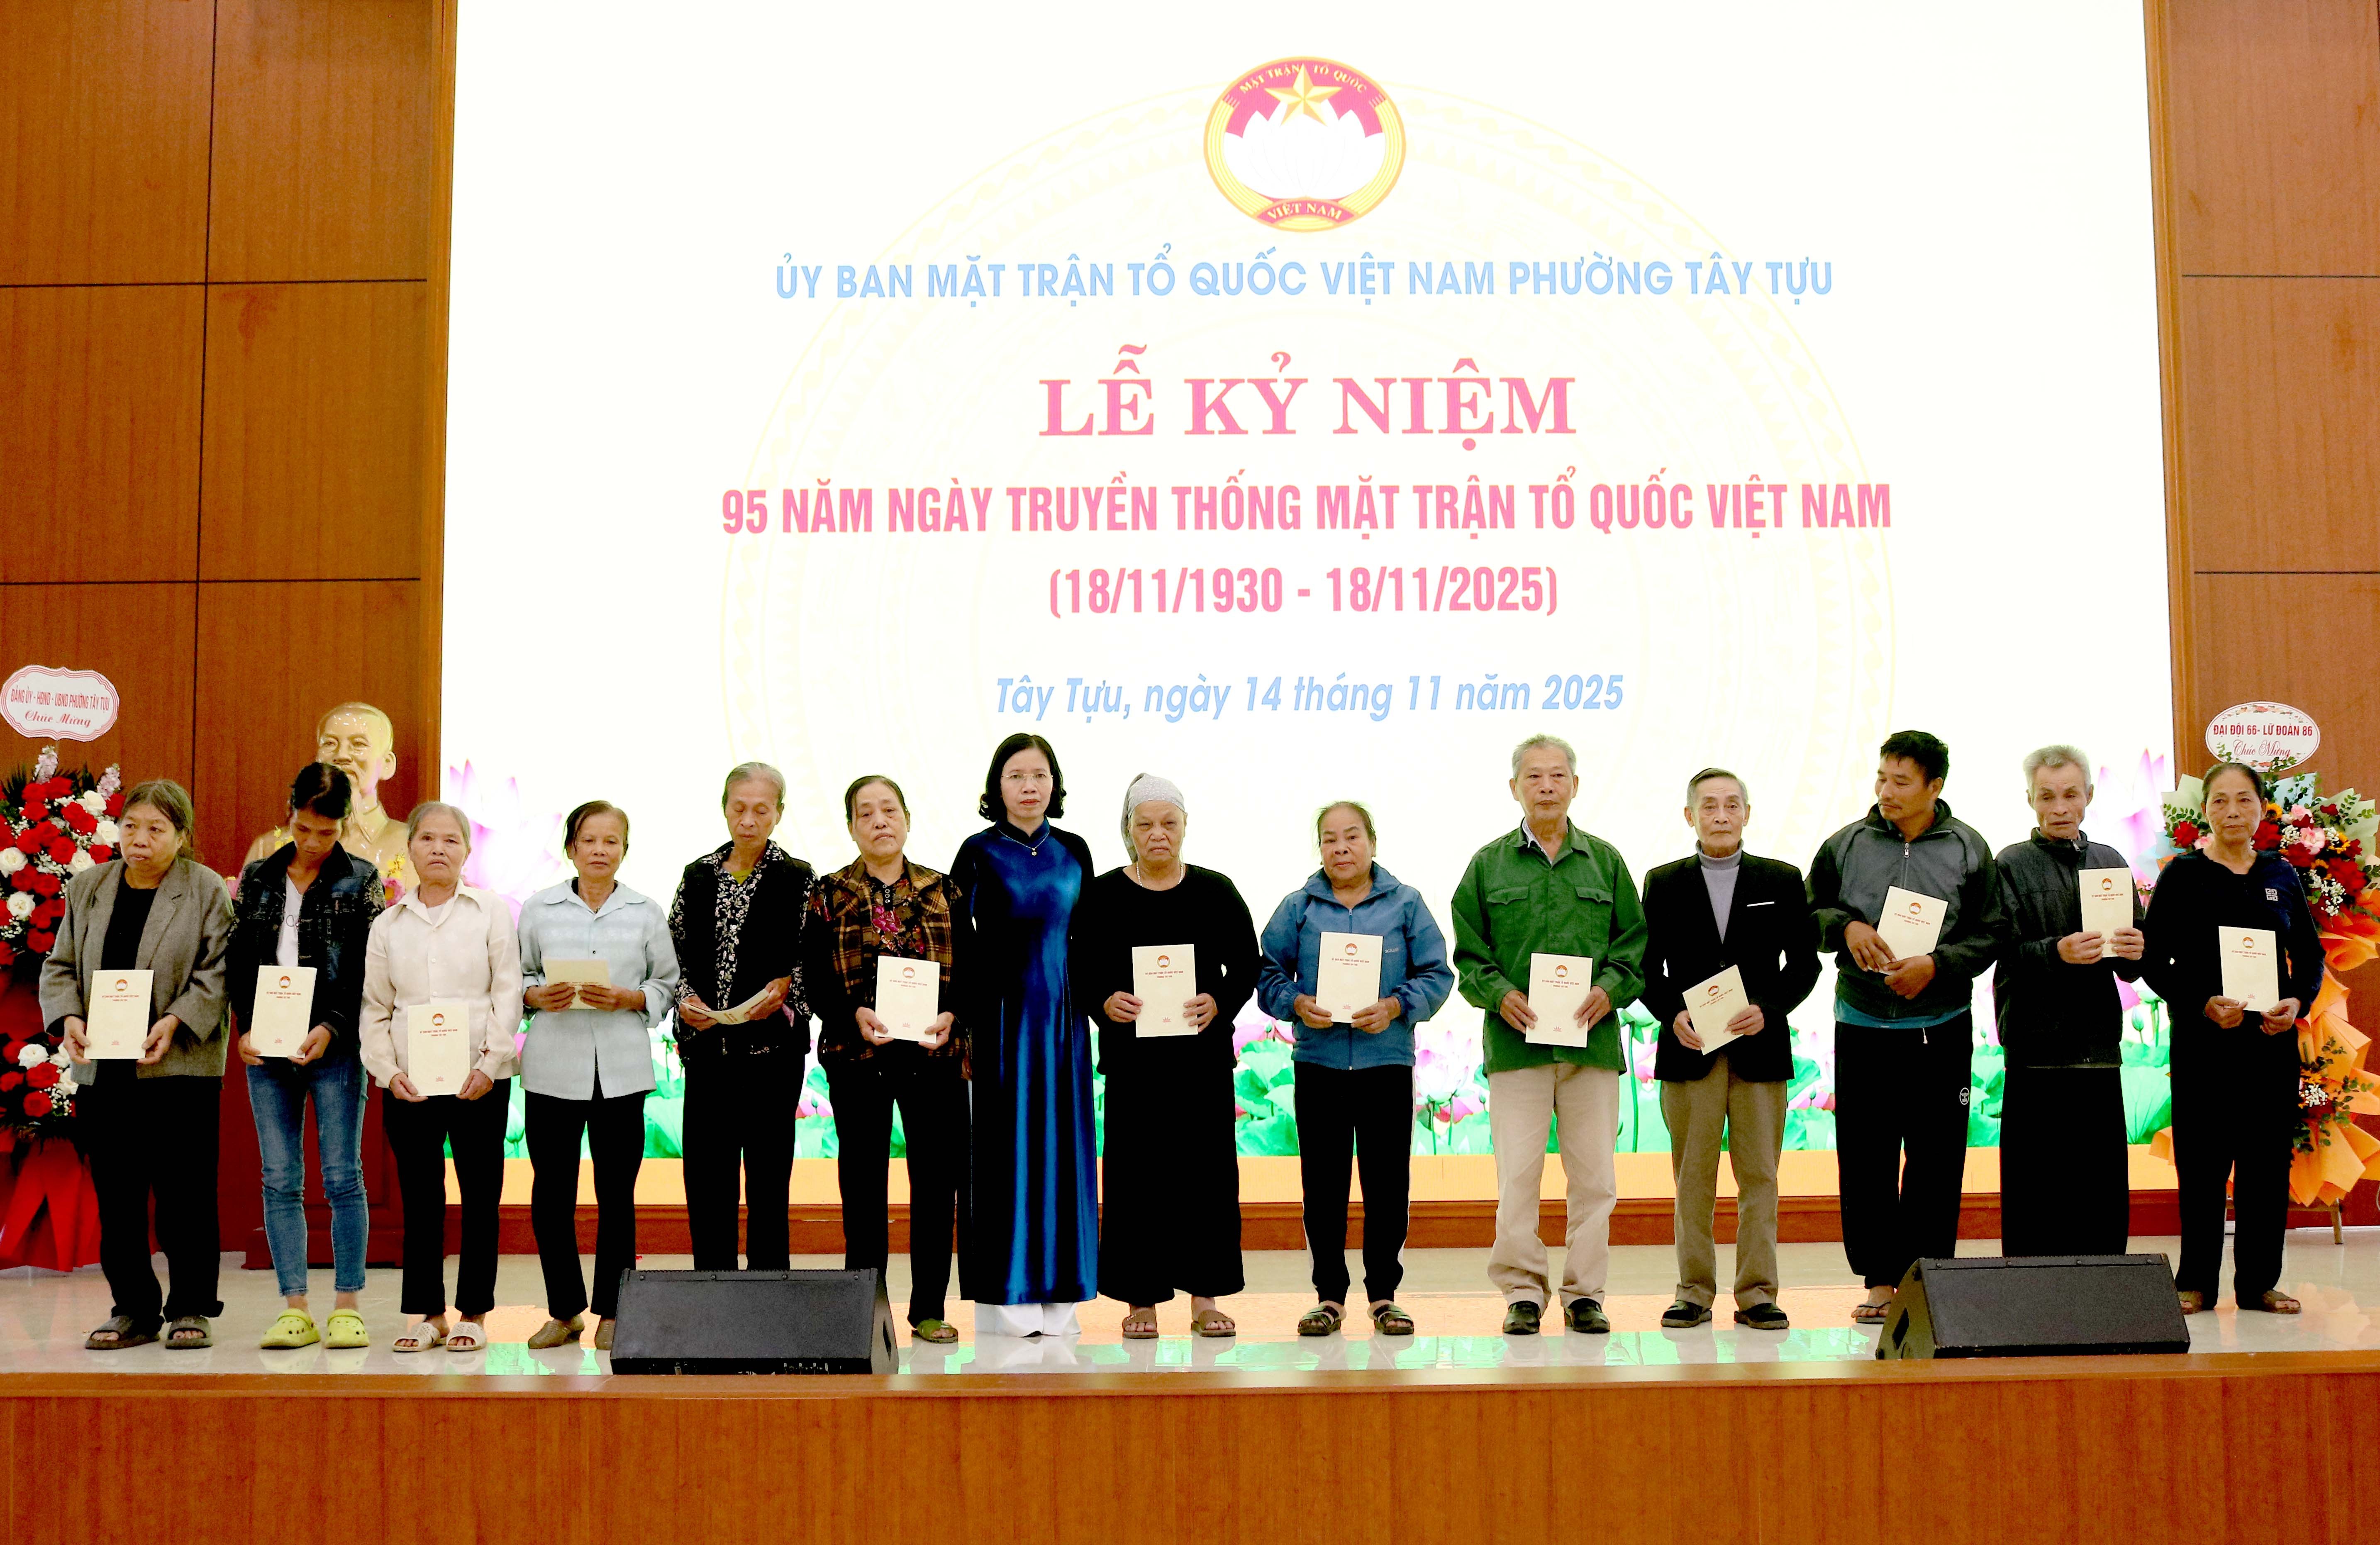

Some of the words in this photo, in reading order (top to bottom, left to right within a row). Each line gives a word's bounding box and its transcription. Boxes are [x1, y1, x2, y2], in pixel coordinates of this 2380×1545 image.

[1267, 202, 1302, 219] VIỆT
[1306, 203, 1342, 219] NAM
[776, 252, 822, 299] ỦY
[837, 265, 912, 298] BAN
[928, 256, 1006, 308] MẶT
[1017, 253, 1114, 307] TRẬN
[1127, 242, 1176, 296] TỔ
[1190, 247, 1306, 296] QUỐC
[1321, 251, 1395, 305] VIỆT
[1409, 261, 1494, 295] NAM
[1510, 251, 1673, 295] PHƯỜNG
[1685, 251, 1753, 295] TÂY
[1765, 257, 1832, 306] TỰU
[1039, 344, 1154, 436] LỄ
[1184, 352, 1308, 435] KỶ
[1333, 358, 1576, 451] NIỆM
[722, 490, 768, 534] 95
[783, 479, 873, 533] NĂM
[888, 478, 992, 533] NGÀY
[1006, 471, 1157, 532] TRUYỀN
[1171, 469, 1301, 531] THỐNG
[1317, 475, 1400, 540] MẶT
[1412, 475, 1515, 540] TRẬN
[1529, 465, 1576, 529] TỔ
[1590, 468, 1693, 534] QUỐC
[1707, 474, 1787, 539] VIỆT
[1801, 484, 1891, 528] NAM
[1050, 567, 1283, 618] (18/11/1930
[1297, 588, 1311, 597] -
[1327, 566, 1557, 616] 18/11/2025)
[11, 685, 24, 703] ĐẢNG
[54, 693, 68, 707] UBND
[90, 694, 100, 710] TÂY
[25, 710, 53, 723] Chúc
[997, 675, 1054, 721] Tây
[1067, 677, 1131, 724] Tựu,
[1144, 674, 1231, 723] ngày
[1247, 676, 1282, 711] 14
[1294, 673, 1393, 722] tháng
[1409, 675, 1441, 711] 11
[1456, 673, 1531, 711] năm
[1542, 674, 1623, 710] 2025
[2213, 725, 2227, 737] ĐẠI
[2230, 722, 2244, 737] ĐỘI
[2263, 723, 2274, 736] LỮ
[2276, 723, 2300, 736] ĐOÀN
[2302, 726, 2312, 736] 86
[2233, 739, 2256, 756] Chúc
[2258, 739, 2291, 760] Mừng
